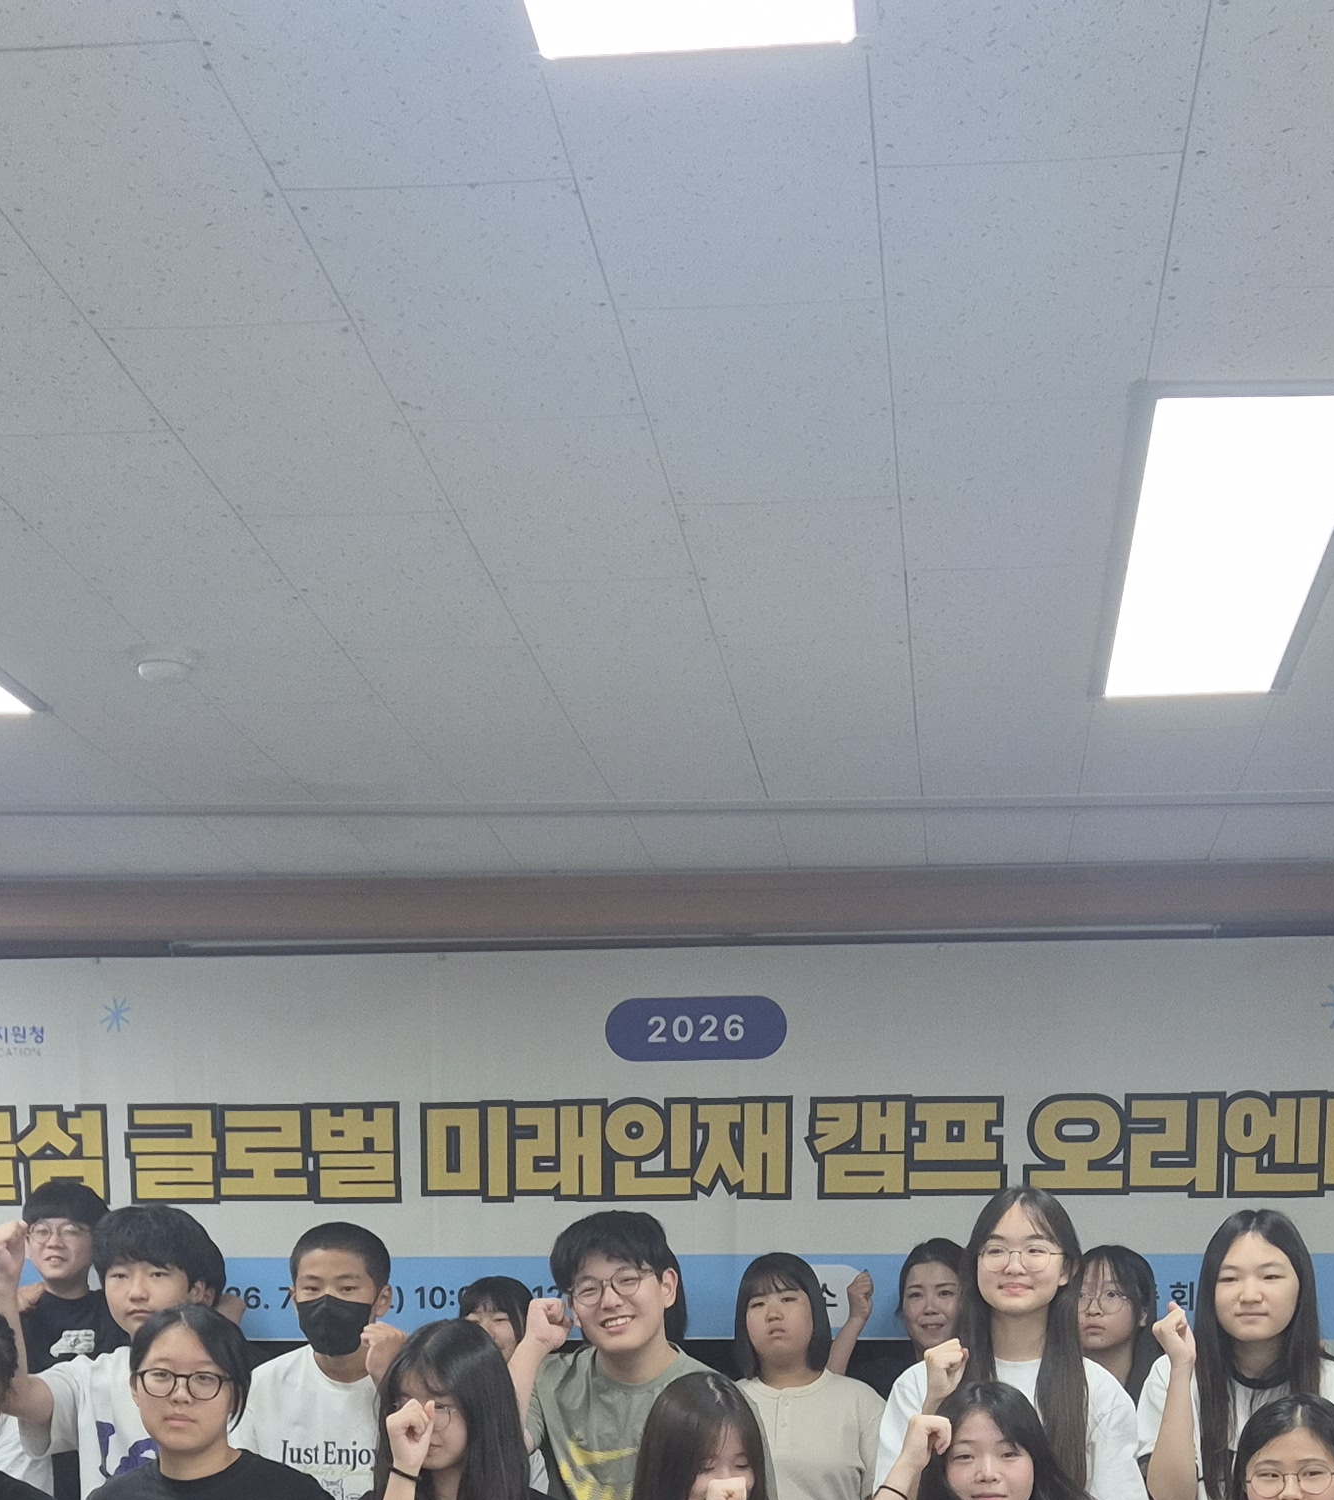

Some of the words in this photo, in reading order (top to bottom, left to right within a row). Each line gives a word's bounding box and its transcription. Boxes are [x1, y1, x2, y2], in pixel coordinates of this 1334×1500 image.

[647, 1014, 745, 1043] 2026
[124, 1101, 402, 1204] 글로벌
[420, 1095, 793, 1203] 미래인재
[804, 1094, 1009, 1200] 캠프
[281, 1439, 319, 1465] Just
[323, 1440, 375, 1471] Enjo
